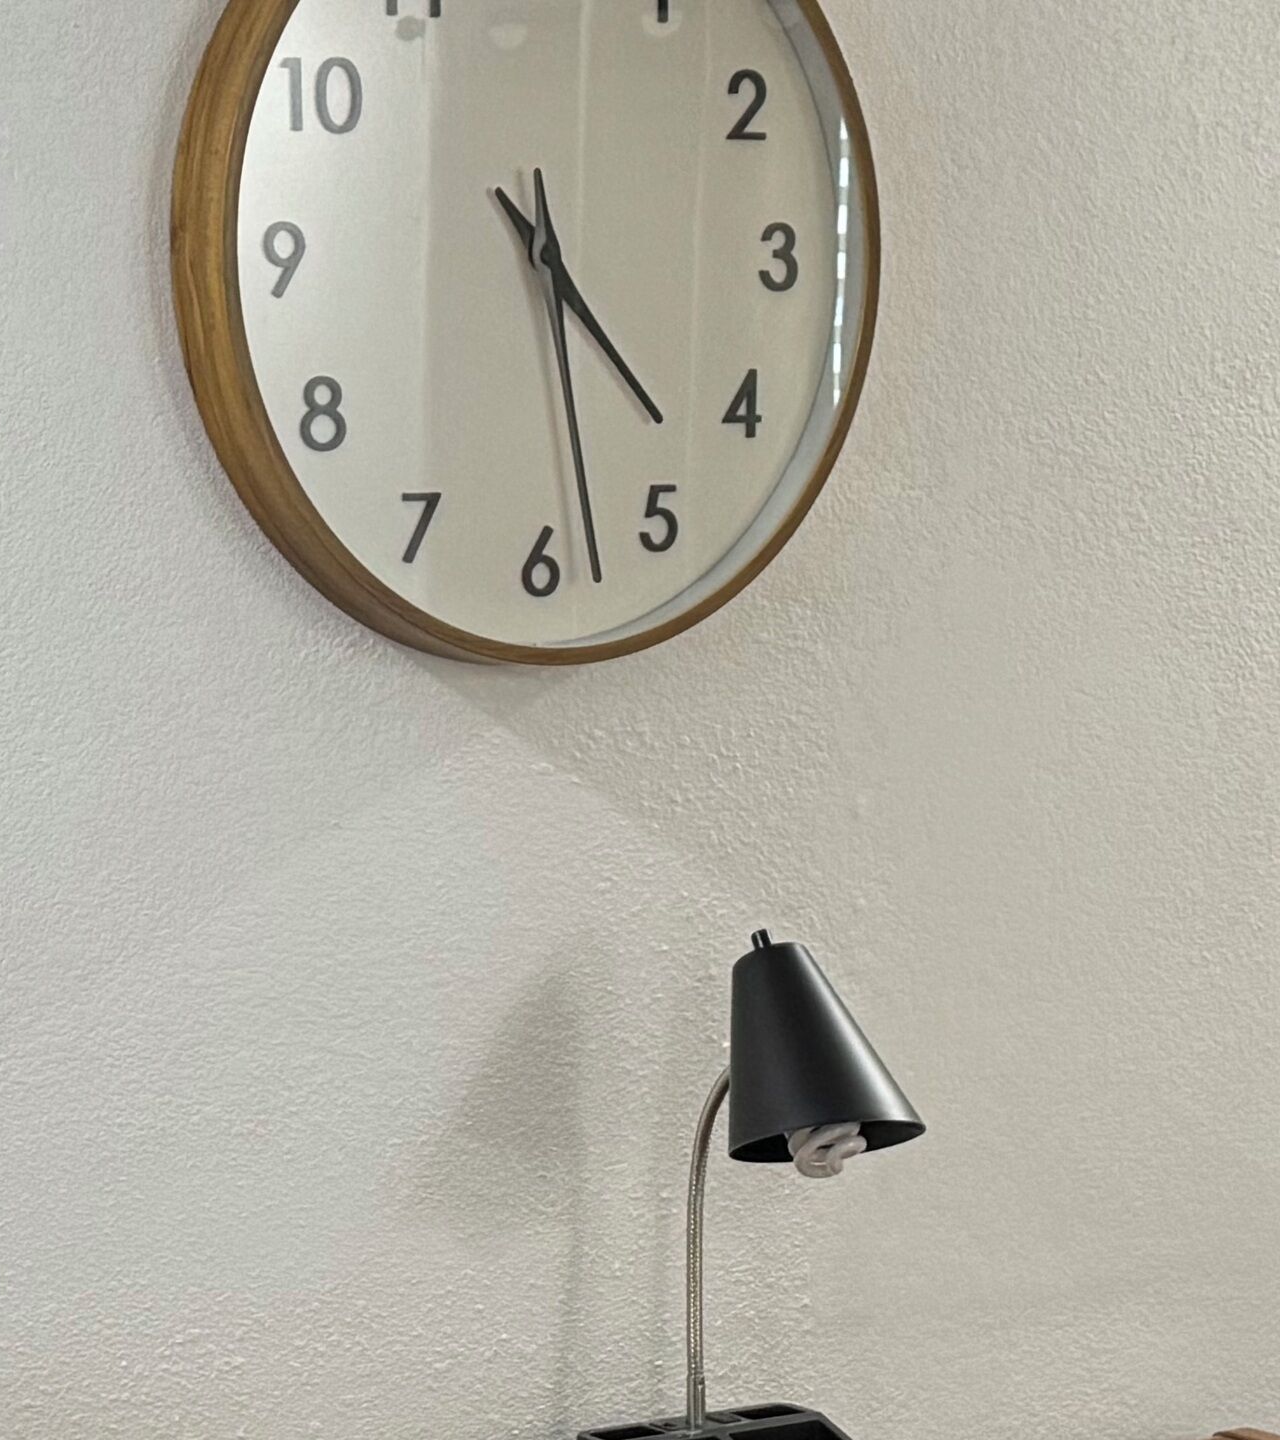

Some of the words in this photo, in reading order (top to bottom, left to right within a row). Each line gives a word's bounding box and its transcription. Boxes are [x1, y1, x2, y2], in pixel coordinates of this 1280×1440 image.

[278, 56, 363, 136] 10
[724, 68, 768, 141] 2
[261, 220, 307, 300] 9
[757, 221, 800, 293] 3
[298, 375, 348, 453] 8
[720, 367, 763, 440] 4
[400, 491, 443, 565] 7
[637, 483, 679, 554] 5
[520, 524, 561, 599] 6
